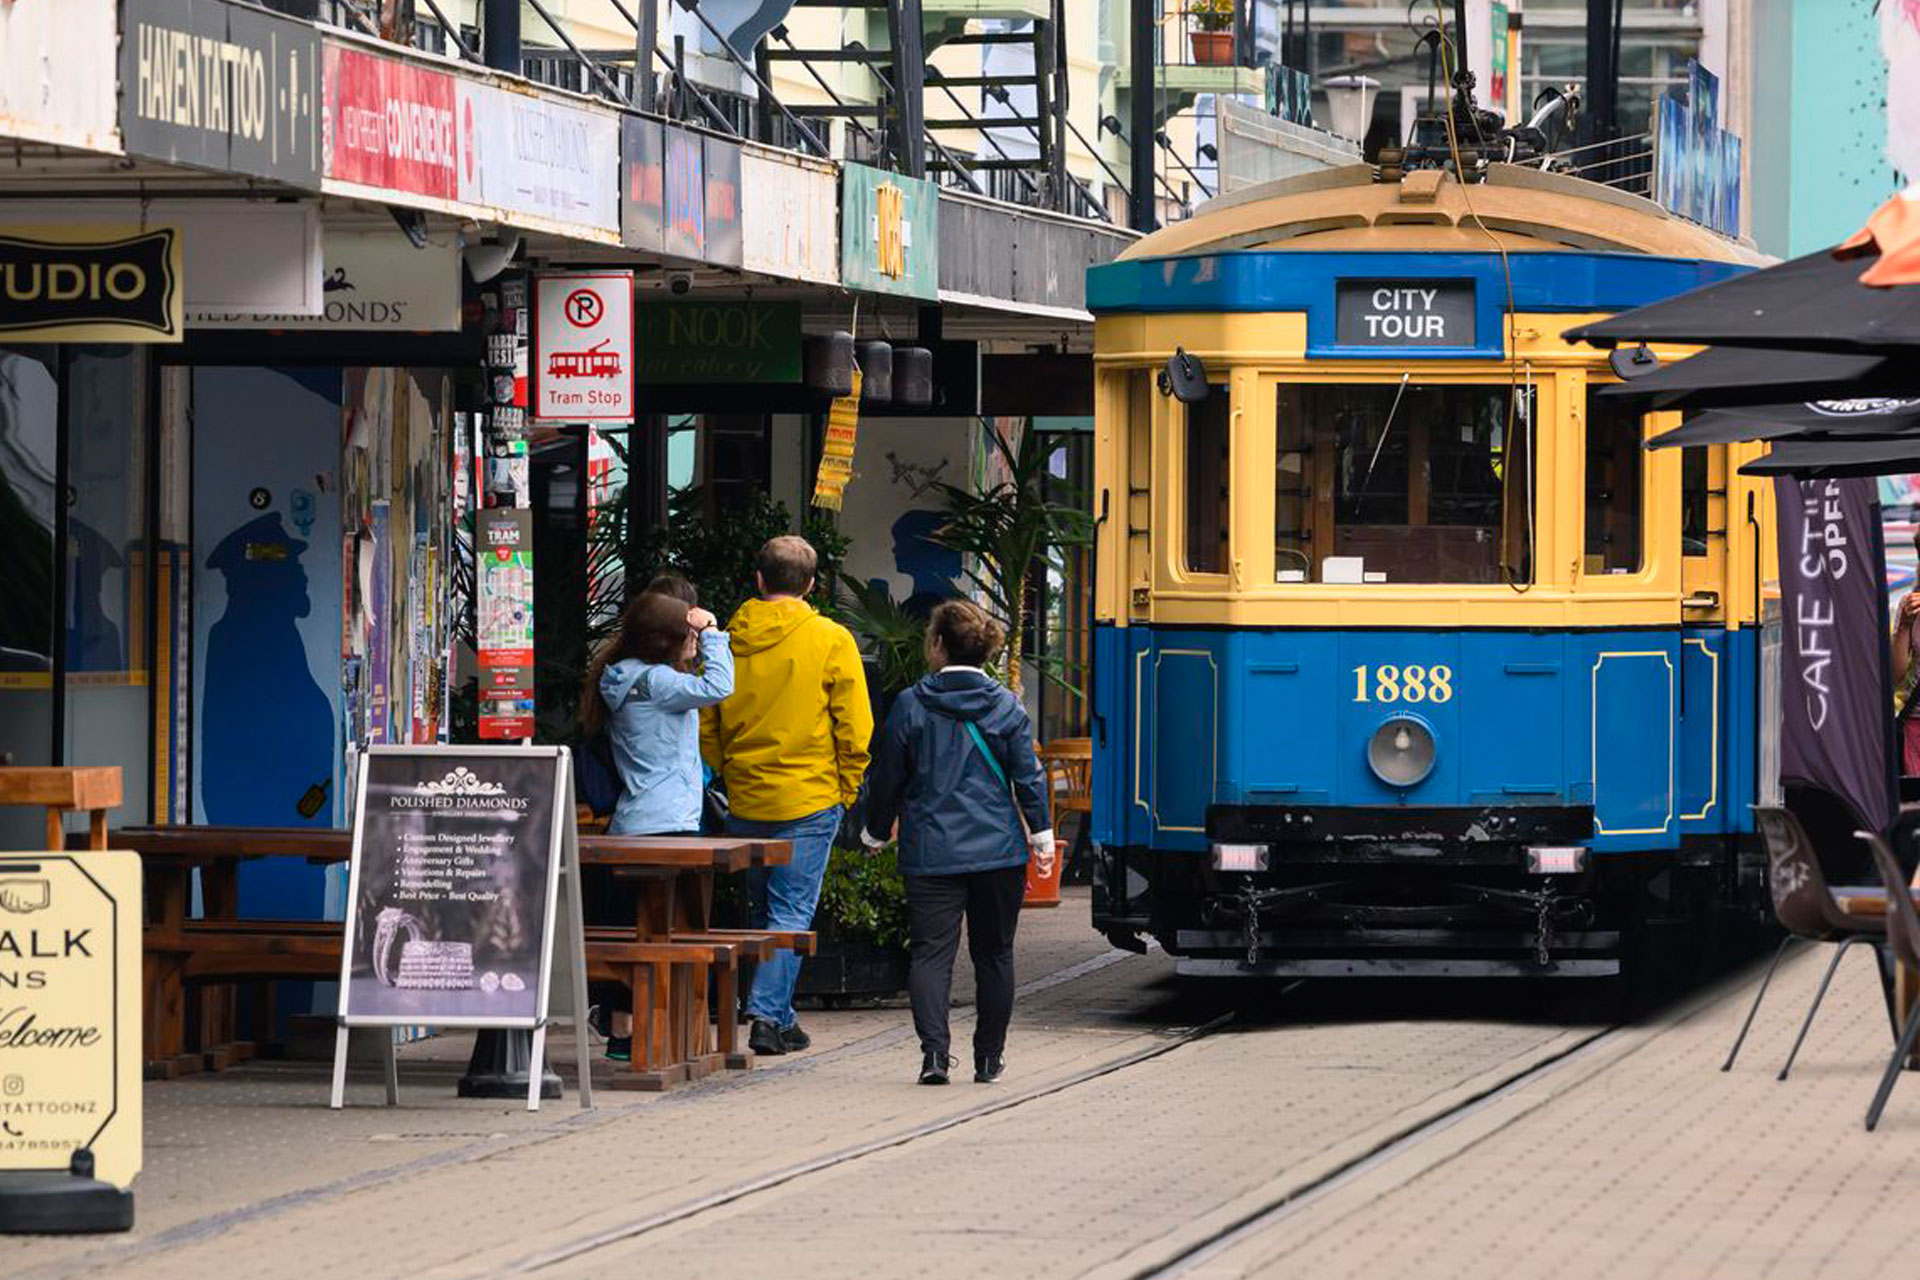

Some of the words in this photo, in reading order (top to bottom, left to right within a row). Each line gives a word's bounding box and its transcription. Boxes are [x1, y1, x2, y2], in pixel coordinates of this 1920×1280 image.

[138, 22, 200, 128] HAVEN
[201, 36, 266, 142] TATTOO
[0, 263, 146, 300] UDIO
[1372, 288, 1438, 311] CITY
[667, 306, 776, 350] NOOK
[1363, 314, 1445, 338] TOUR
[549, 390, 583, 404] Tram
[587, 390, 622, 407] Stop
[487, 530, 520, 541] TRAM
[1798, 593, 1834, 732] CAFE
[1351, 664, 1453, 703] 1888
[390, 796, 453, 808] POLISHED
[456, 797, 529, 809] DIAMONDS
[403, 832, 436, 842] Custom
[438, 832, 477, 844] Designed
[455, 844, 463, 853] &
[465, 845, 502, 856] Wedding
[402, 856, 452, 867] Anniversary
[453, 856, 475, 866] Gifts
[401, 867, 444, 877] Valuations
[446, 868, 454, 877] &
[455, 868, 487, 879] Repairs
[399, 879, 452, 890] Remodelling
[399, 891, 417, 901] Best
[418, 891, 440, 901] Price
[448, 891, 466, 901] Best
[468, 891, 500, 902] Quality
